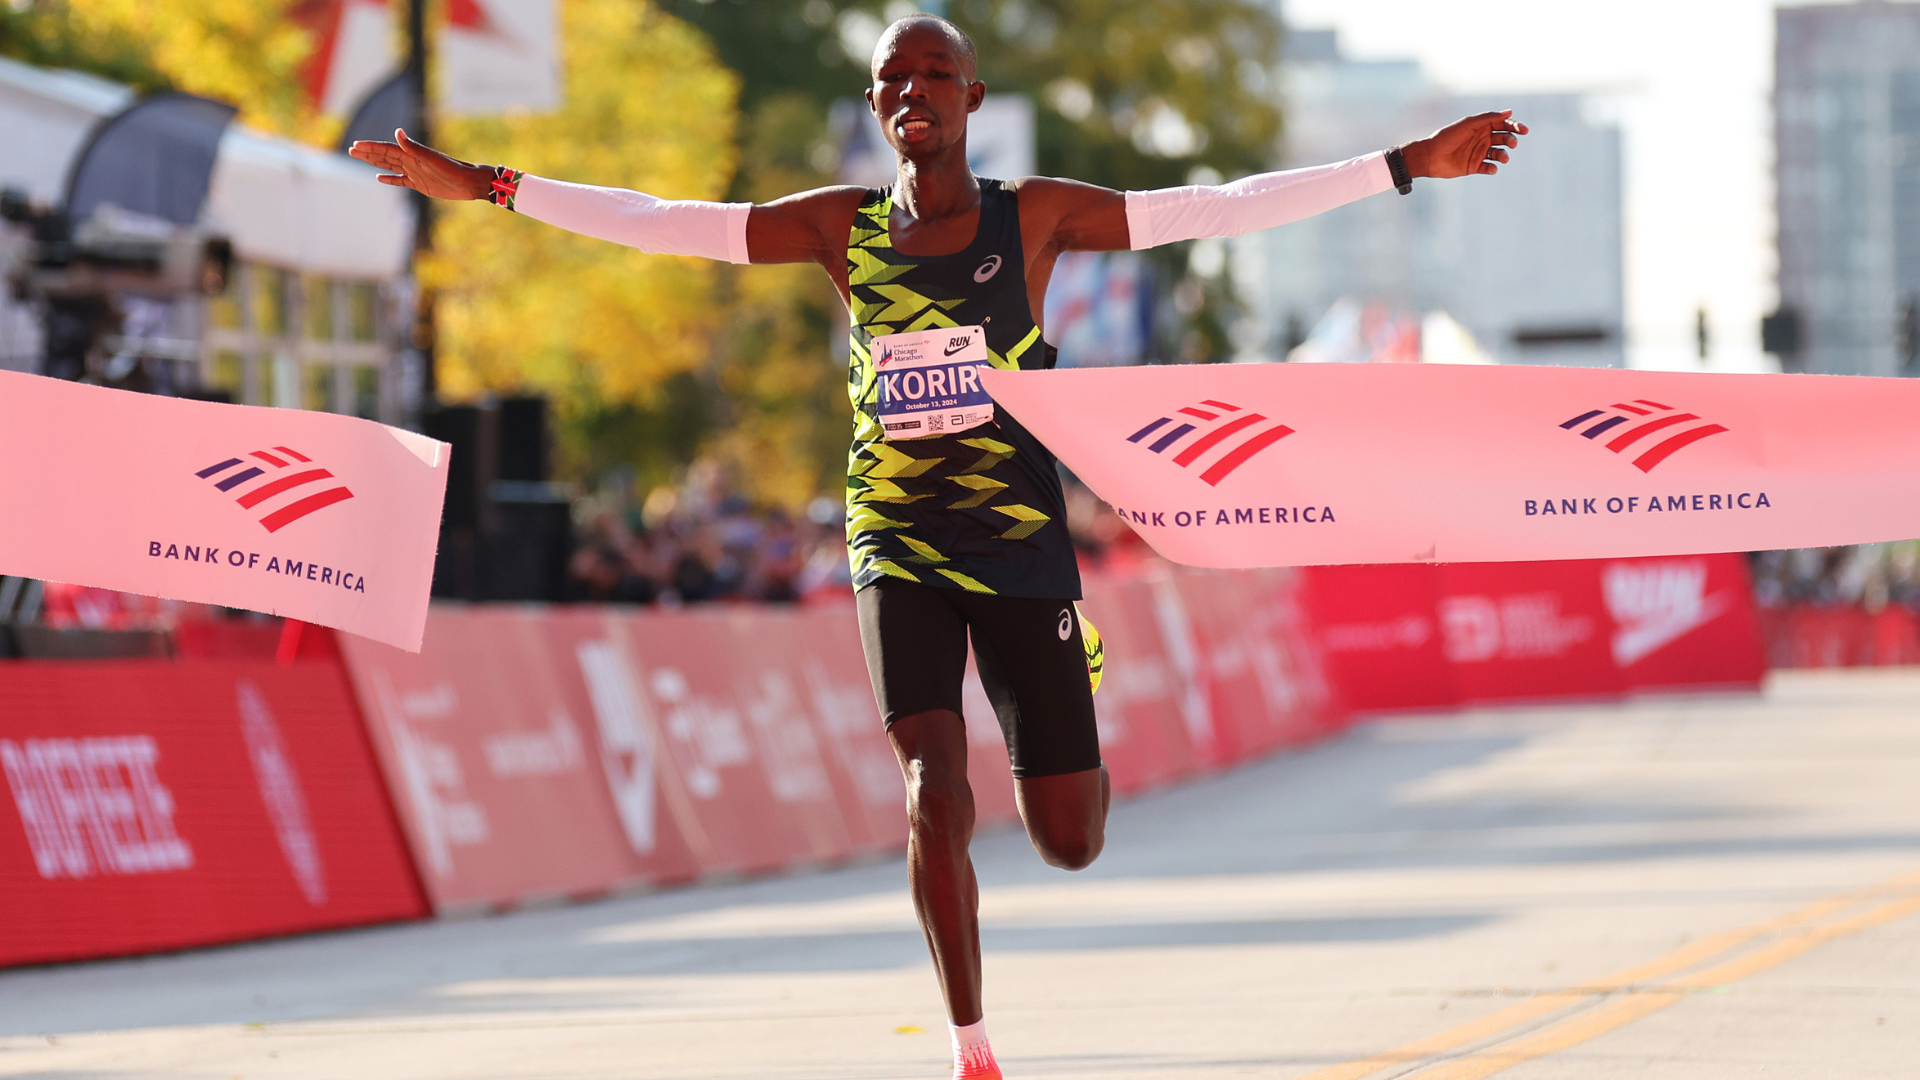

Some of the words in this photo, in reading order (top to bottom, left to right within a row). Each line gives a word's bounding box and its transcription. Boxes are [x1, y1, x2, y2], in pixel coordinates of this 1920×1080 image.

[894, 348, 917, 356] Chicago
[949, 336, 970, 347] RUN
[894, 354, 924, 362] Marathon
[884, 365, 979, 402] KORIR
[1525, 498, 1598, 516] BANK
[1606, 496, 1639, 514] OF
[1647, 492, 1771, 512] AMERICA
[1175, 510, 1207, 527] OF
[1215, 506, 1336, 525] AMERICA
[148, 541, 219, 564] BANK
[228, 550, 260, 569] OF
[266, 557, 365, 593] AMERICA
